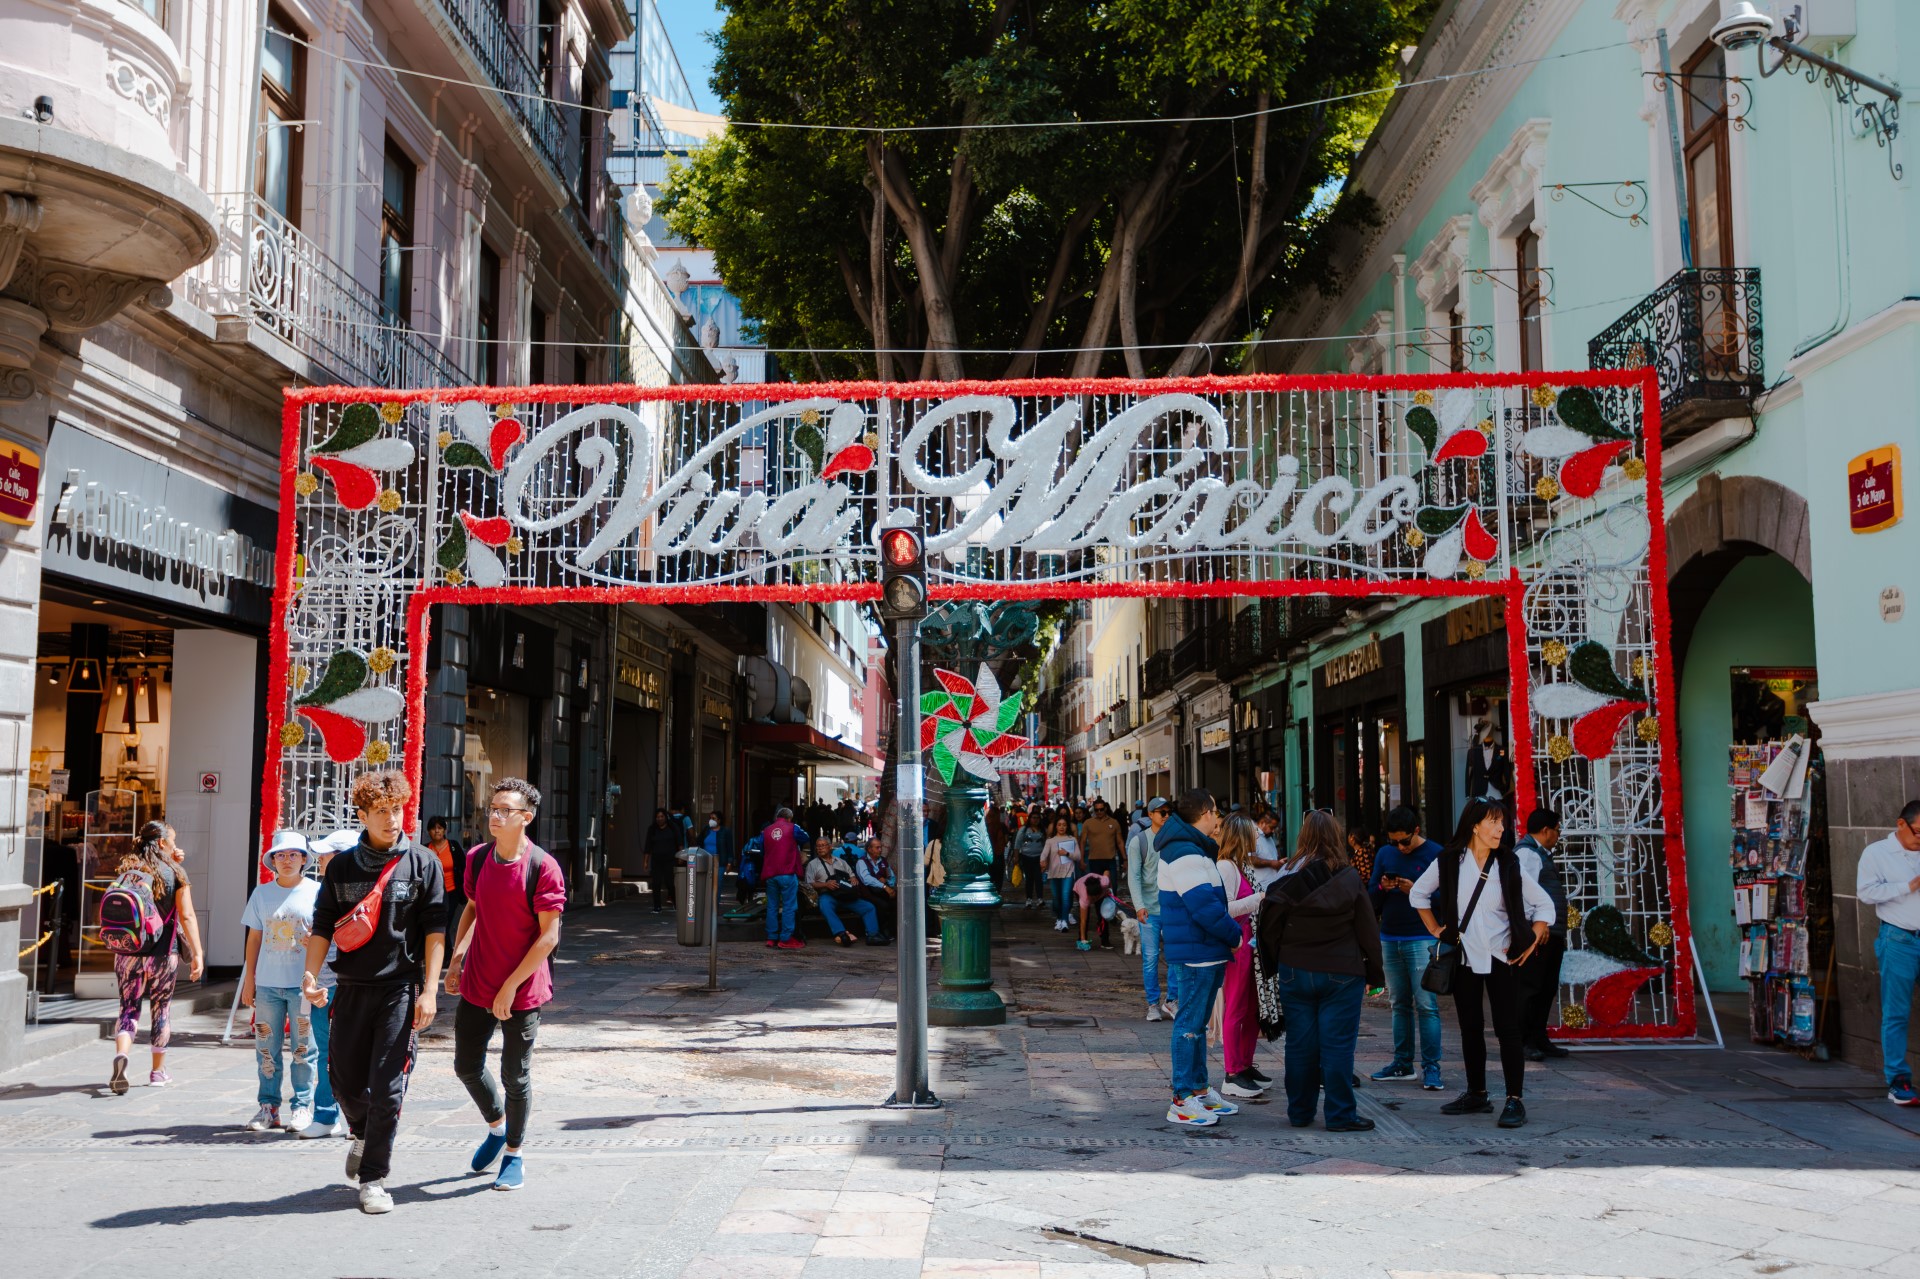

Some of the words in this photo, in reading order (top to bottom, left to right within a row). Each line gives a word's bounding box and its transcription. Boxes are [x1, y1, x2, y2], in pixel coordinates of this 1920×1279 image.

[8, 467, 21, 481] Calle
[503, 398, 860, 570] Viva
[872, 392, 1420, 554] México
[1864, 475, 1876, 488] Calle
[3, 479, 12, 494] de
[12, 481, 29, 501] Mayo
[1862, 491, 1869, 506] de
[1870, 488, 1886, 504] Mayo
